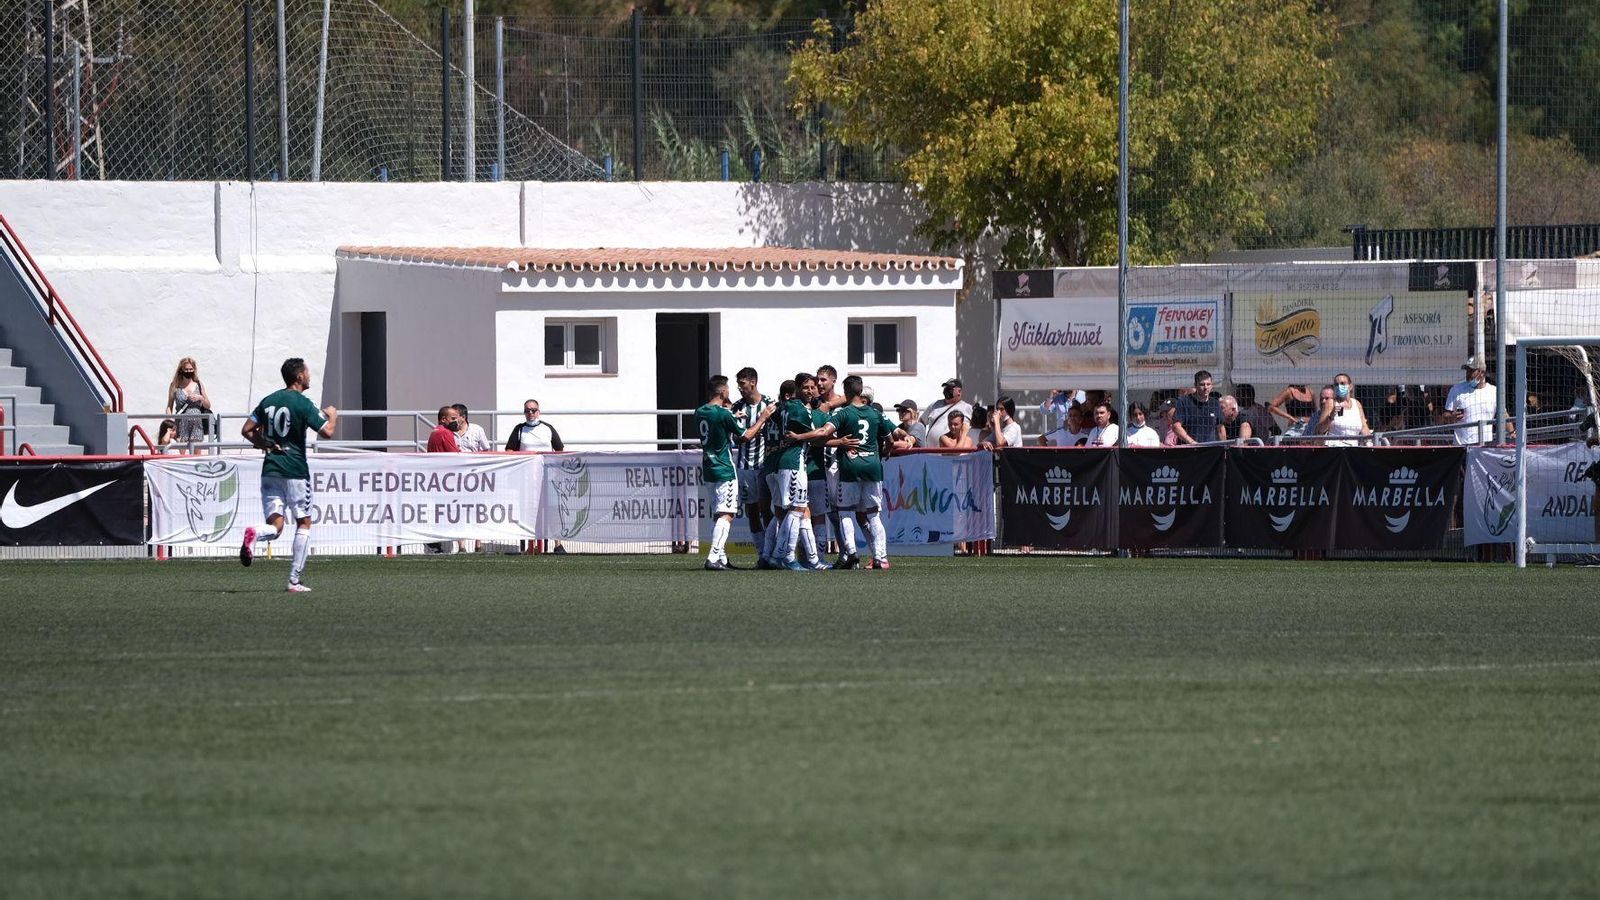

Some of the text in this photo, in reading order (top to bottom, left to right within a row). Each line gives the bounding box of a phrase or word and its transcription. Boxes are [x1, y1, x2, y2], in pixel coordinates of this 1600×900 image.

[1008, 322, 1103, 352] Mäklarhuset
[1259, 319, 1315, 348] Troyano
[264, 405, 291, 438] 10
[699, 420, 710, 445] 9
[857, 419, 870, 446] 3
[313, 469, 496, 493] EAL FEDERACIÓN
[626, 466, 706, 488] REAL FEDER
[1015, 485, 1101, 506] MARBELLA
[1119, 484, 1212, 506] MARBELLA
[1240, 485, 1330, 507] MARBELLA
[1352, 484, 1446, 507] MARBELLA
[1541, 494, 1596, 518] ANDAL
[401, 503, 428, 524] DE
[434, 499, 520, 524] FÚTBOL
[612, 498, 684, 521] ANDALUZA
[688, 498, 705, 519] DE
